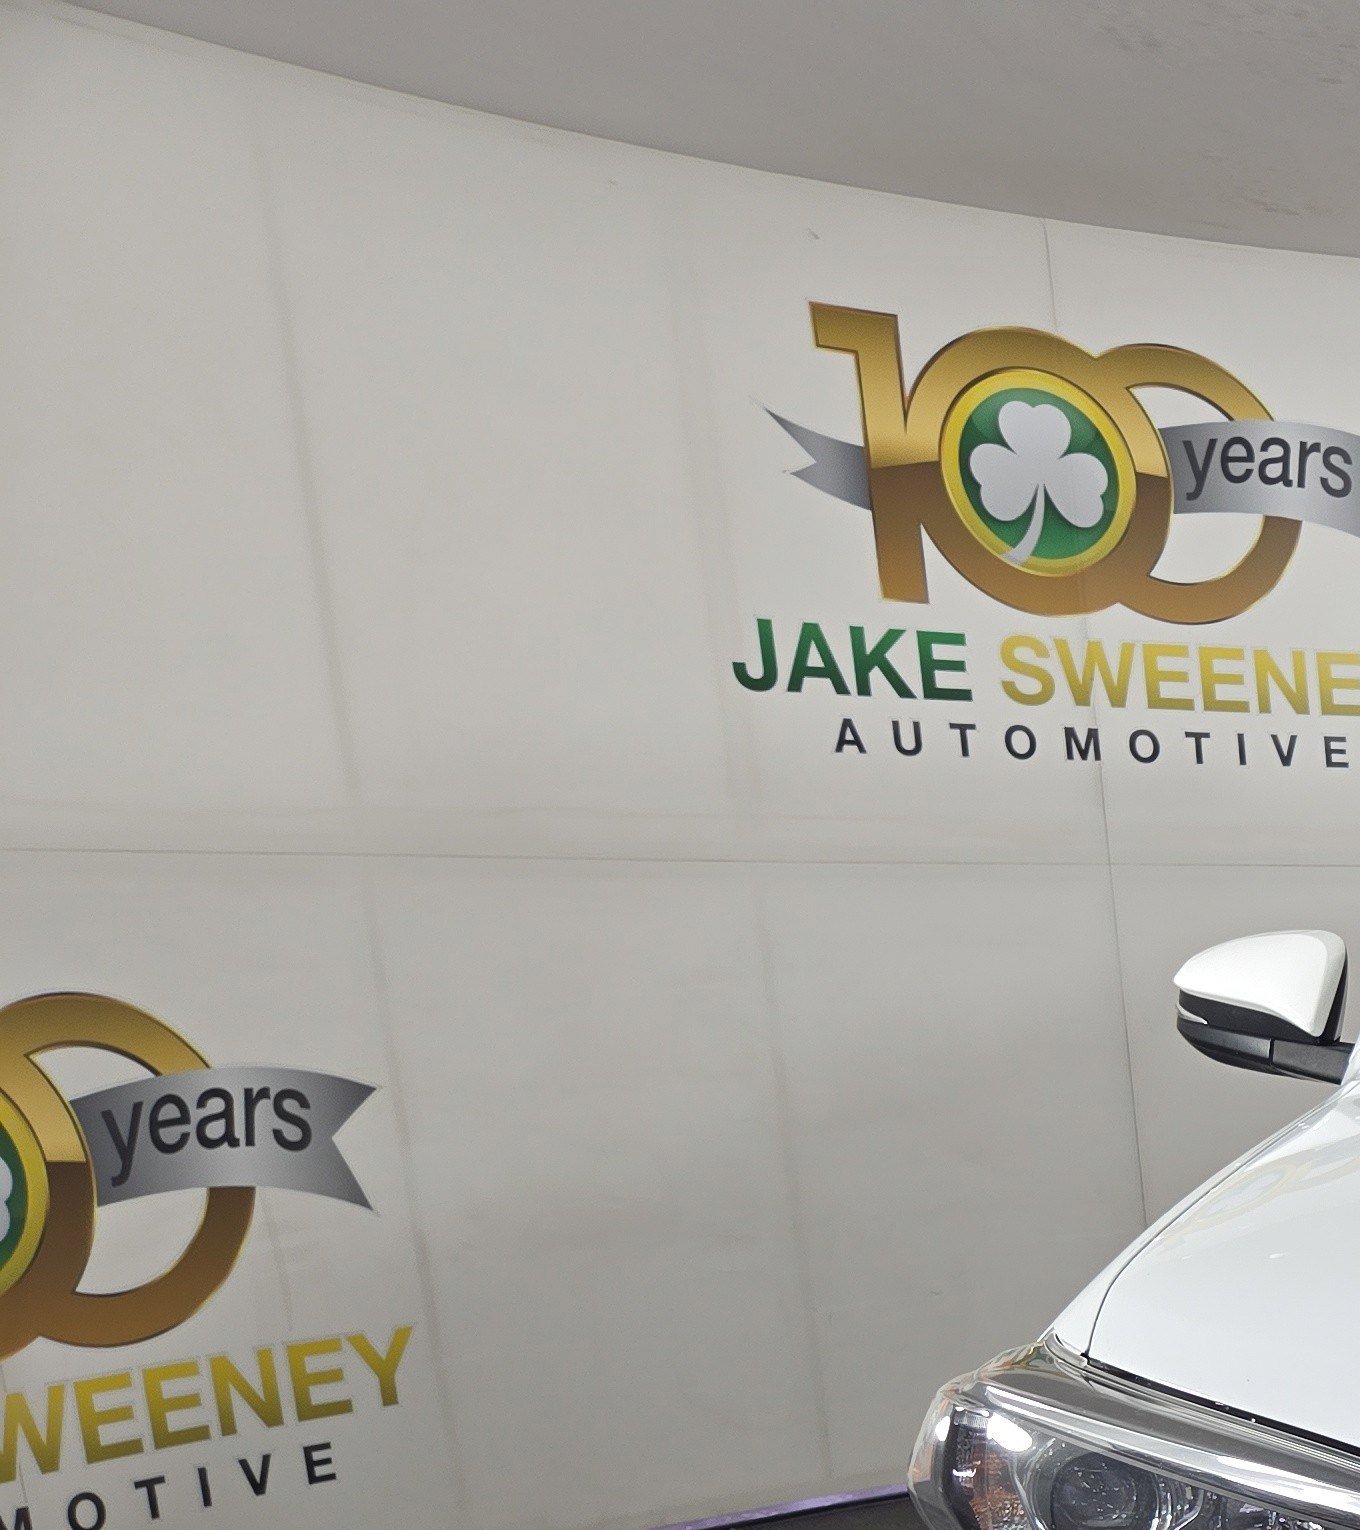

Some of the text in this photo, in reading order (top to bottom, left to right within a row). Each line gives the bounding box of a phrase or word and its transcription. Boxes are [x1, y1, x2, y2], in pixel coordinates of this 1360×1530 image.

[1181, 434, 1354, 502] years
[731, 618, 973, 702] JAKE
[834, 717, 1350, 768] AUTOMOTIVE
[101, 1085, 313, 1188] years
